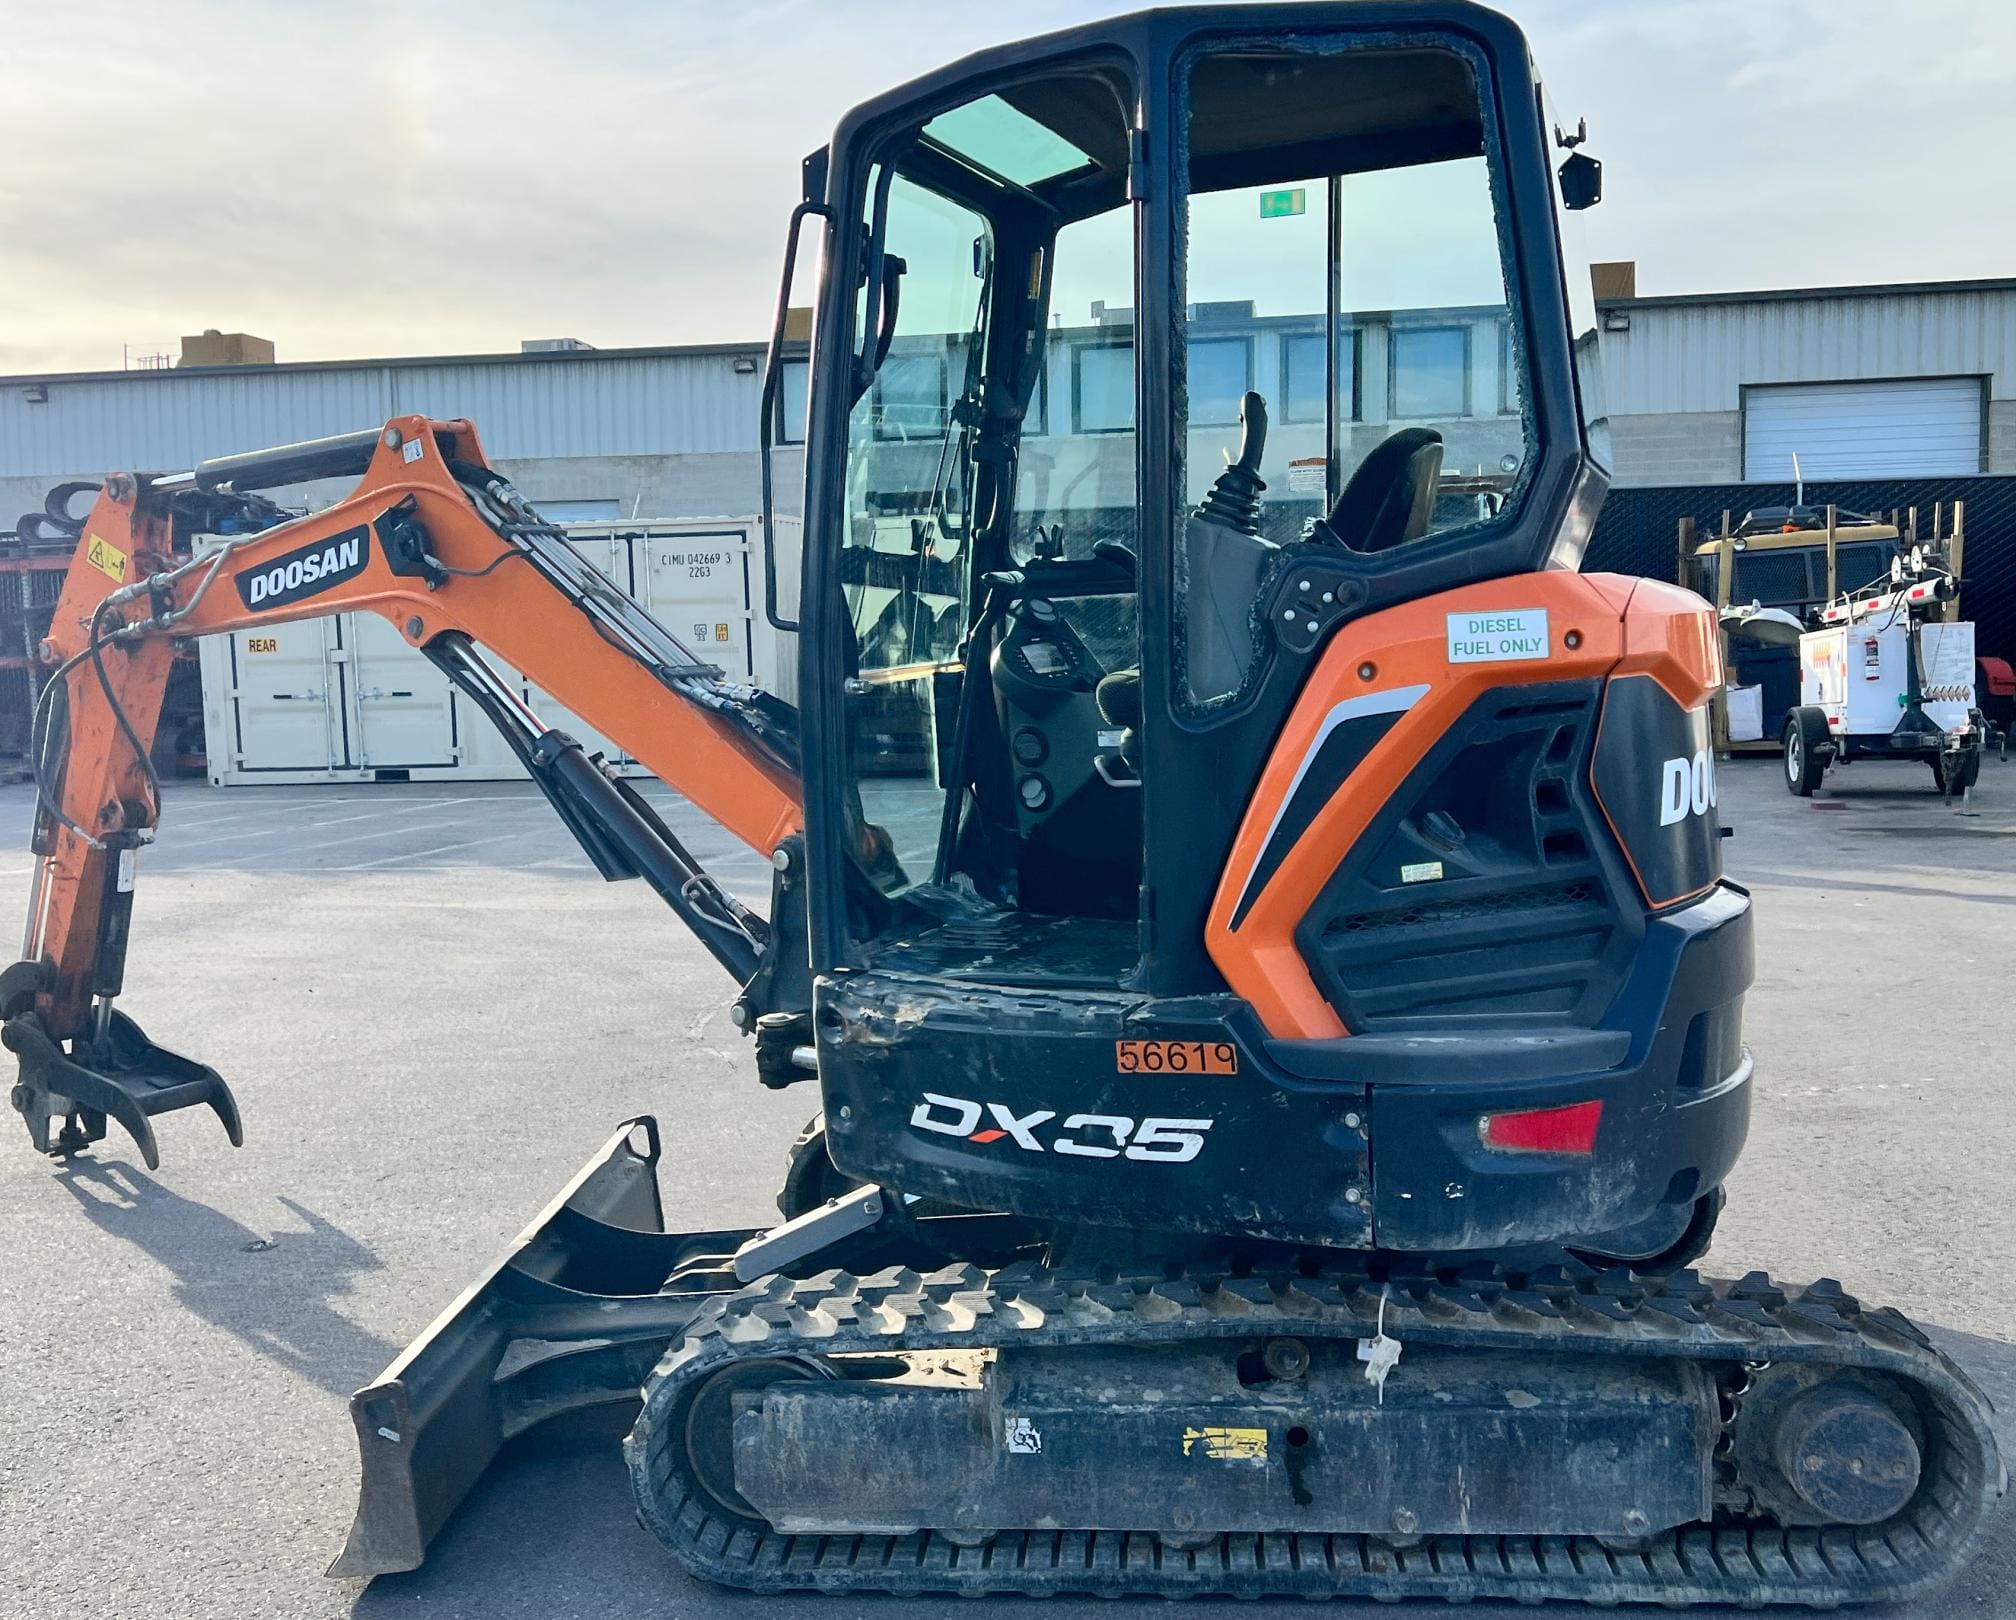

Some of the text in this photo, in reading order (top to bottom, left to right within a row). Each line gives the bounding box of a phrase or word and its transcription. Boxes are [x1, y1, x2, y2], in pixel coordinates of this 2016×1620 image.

[661, 552, 731, 566] CIMU 042669 3
[250, 538, 359, 604] DOOSAN
[689, 566, 711, 578] 22G3
[1469, 618, 1527, 634] DIESEL
[249, 639, 277, 652] REAR
[1454, 638, 1542, 656] FUEL ONLY
[1119, 1041, 1237, 1073] 56619
[910, 1092, 1214, 1162] DX35
